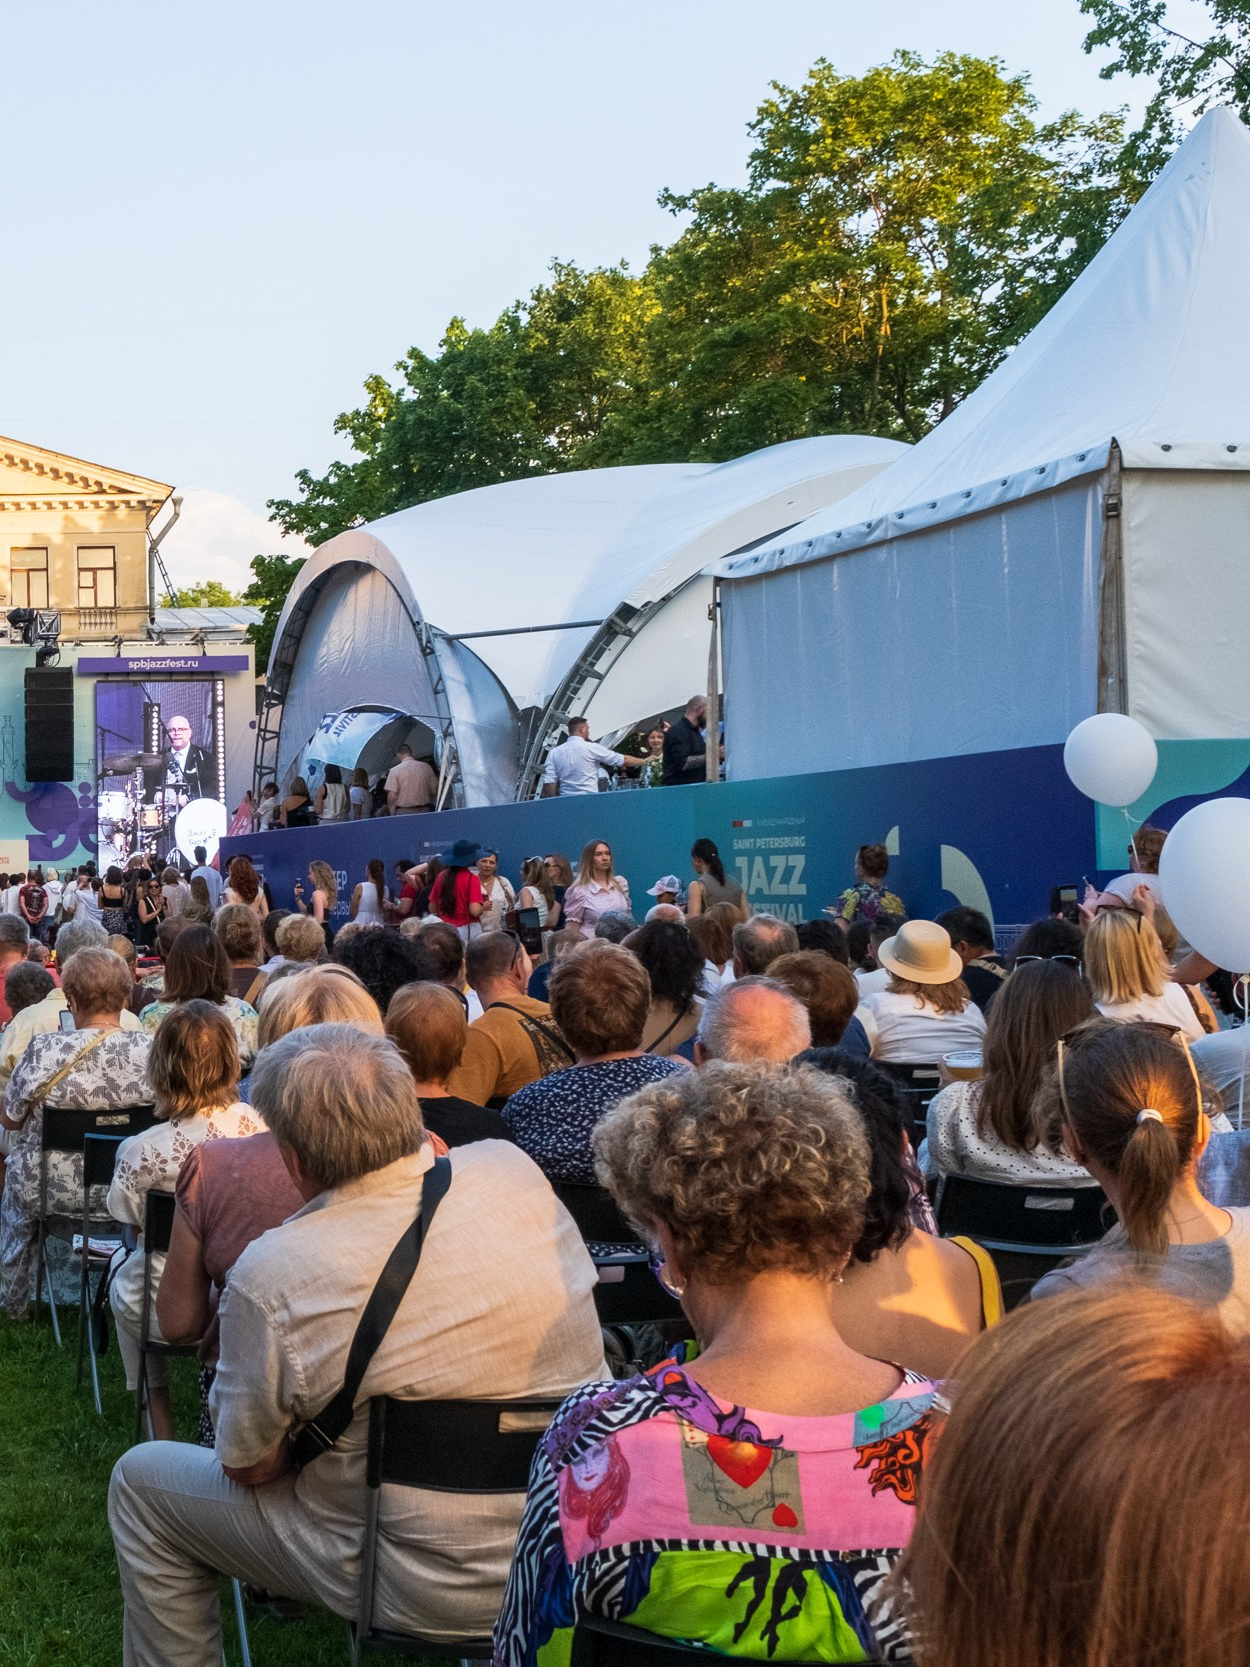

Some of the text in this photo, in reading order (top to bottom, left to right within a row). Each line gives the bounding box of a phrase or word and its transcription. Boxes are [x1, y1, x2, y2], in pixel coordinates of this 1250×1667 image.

[128, 659, 199, 670] spbjazzfest.ru
[733, 836, 806, 850] SAINT PETERSBURG
[735, 854, 807, 895] JAZZ
